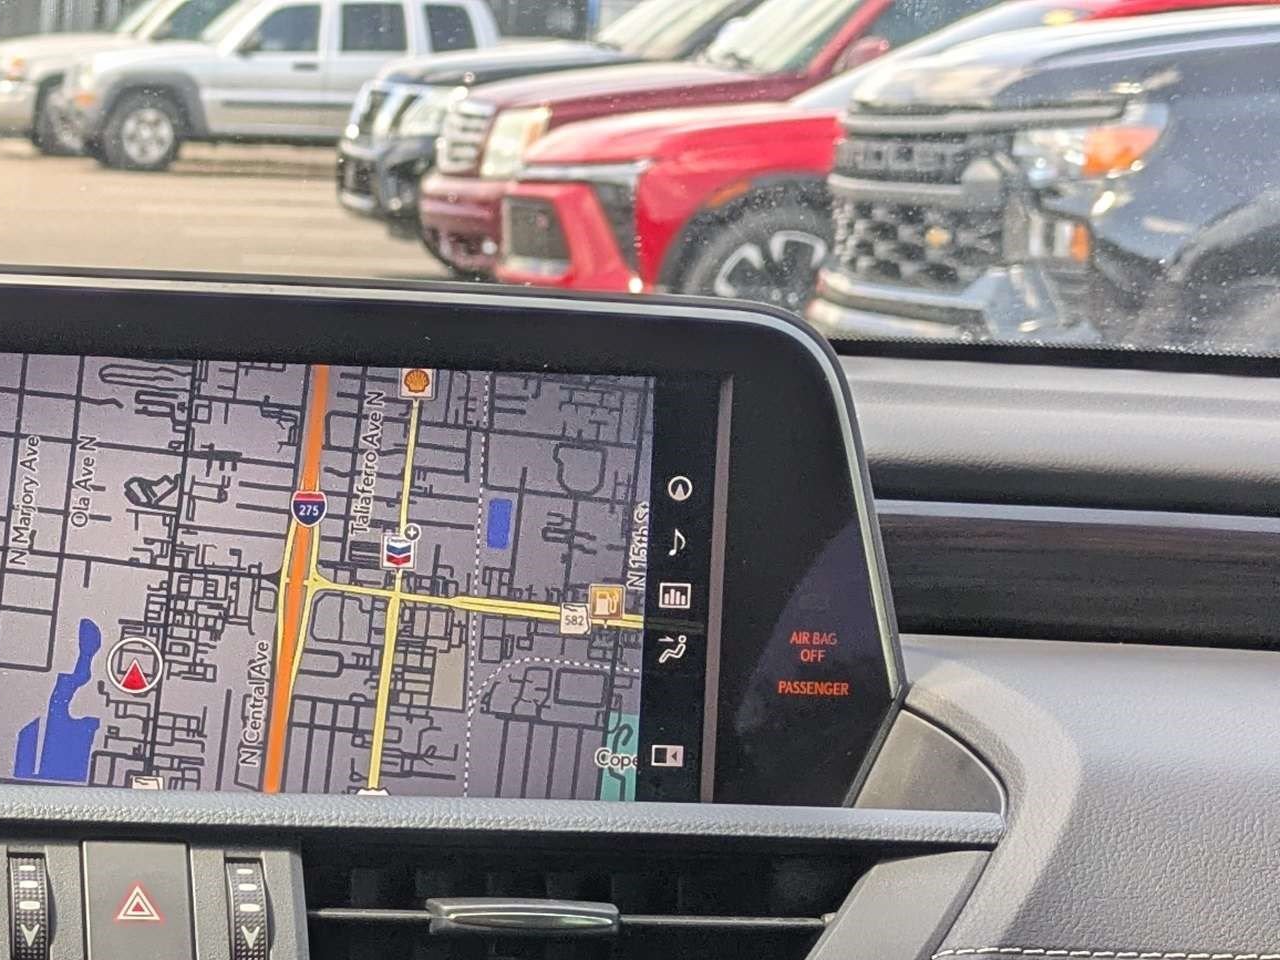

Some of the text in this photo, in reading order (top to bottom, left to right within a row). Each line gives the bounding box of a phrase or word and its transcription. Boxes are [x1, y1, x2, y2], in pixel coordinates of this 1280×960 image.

[351, 391, 384, 535] Taliaferro Ave N
[72, 436, 97, 527] Ola Ave N
[10, 436, 40, 565] N Marjory Ave
[299, 504, 319, 516] 275
[631, 527, 648, 568] 15th
[628, 574, 646, 589] N
[565, 615, 585, 626] 582
[789, 631, 838, 645] AIR BAG
[800, 648, 826, 662] OFF
[778, 680, 850, 696] PASSENGER
[242, 641, 269, 766] N Central Ave
